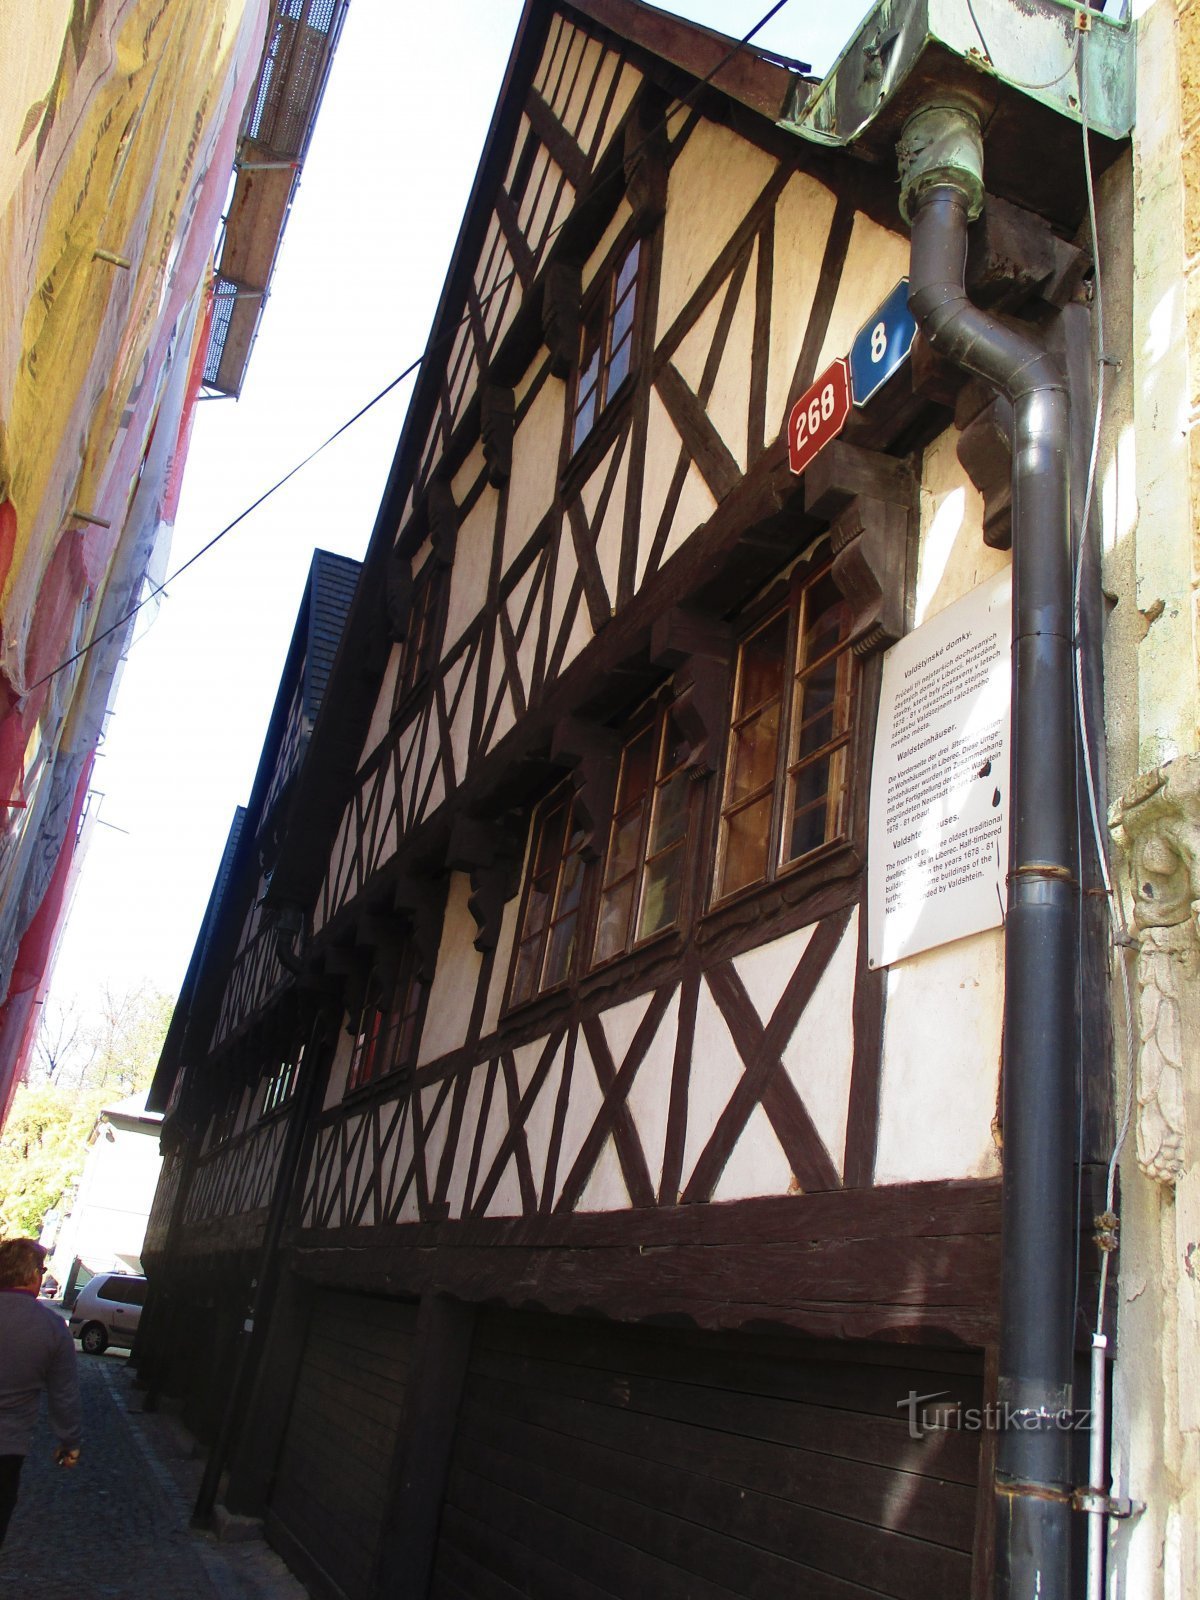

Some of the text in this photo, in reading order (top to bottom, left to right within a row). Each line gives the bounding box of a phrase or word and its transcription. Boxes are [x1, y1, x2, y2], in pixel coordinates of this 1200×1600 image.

[871, 322, 887, 363] 8
[796, 383, 834, 451] 268
[946, 631, 972, 652] domky.
[955, 683, 962, 692] na
[965, 668, 988, 686] stejnou
[898, 724, 956, 762] Waldsteinhäuser.
[962, 741, 978, 754] Diese
[897, 758, 927, 779] Vorderseite
[928, 753, 936, 762] der
[938, 745, 949, 757] drei
[922, 770, 942, 786] wurden
[944, 766, 951, 774] im
[954, 738, 1003, 769] Zusammenhang
[896, 800, 904, 809] der
[943, 776, 951, 785] der
[922, 787, 948, 806] Neustadt
[886, 862, 895, 871] The
[897, 854, 912, 867] fronts
[914, 850, 920, 859] of
[949, 828, 968, 844] oldest
[970, 813, 1002, 835] traditional
[928, 857, 933, 865] in
[936, 847, 958, 861] Liberec.
[960, 825, 1001, 850] Half-timbered
[933, 863, 943, 873] the
[945, 855, 961, 870] years
[941, 865, 969, 882] buildings
[972, 859, 978, 869] of
[981, 855, 992, 865] the
[939, 885, 946, 894] by
[948, 870, 984, 889] Valdshtein.
